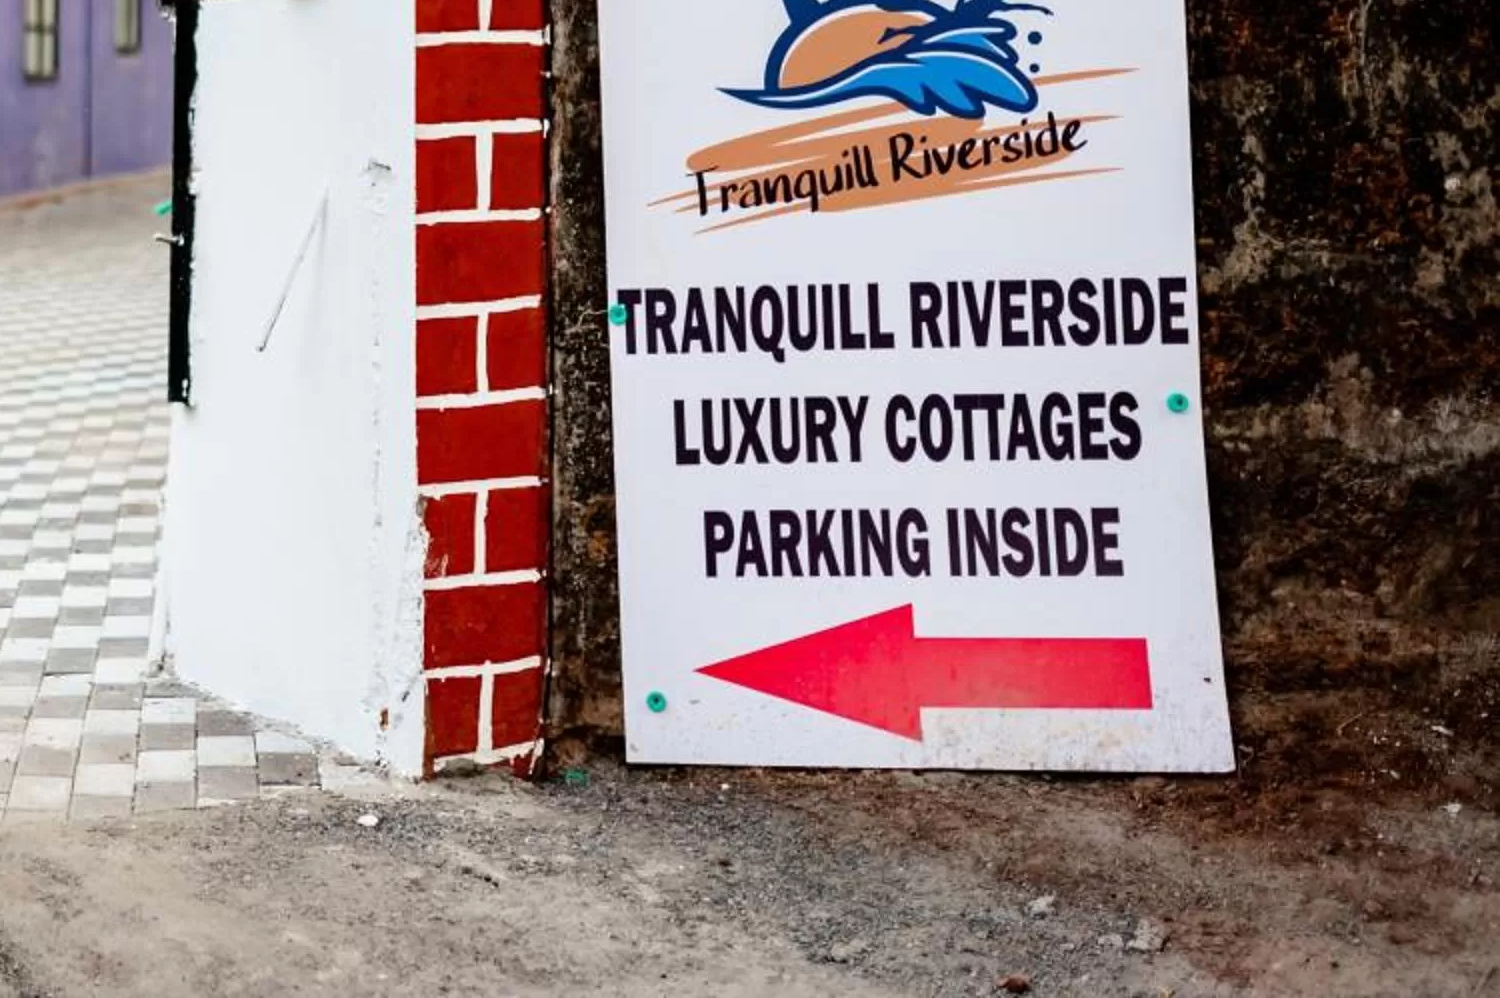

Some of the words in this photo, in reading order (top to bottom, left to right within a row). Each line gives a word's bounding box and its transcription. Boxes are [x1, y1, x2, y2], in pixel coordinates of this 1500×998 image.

[687, 145, 878, 216] Tranquill
[891, 112, 1087, 181] Riverside
[616, 282, 895, 363] TRANQUILL
[909, 277, 1190, 349] RIVERSIDE
[673, 395, 869, 466] LUXURY
[885, 391, 1142, 463] COTTAGES
[703, 507, 931, 578] PARKING
[946, 506, 1125, 577] INSIDE
